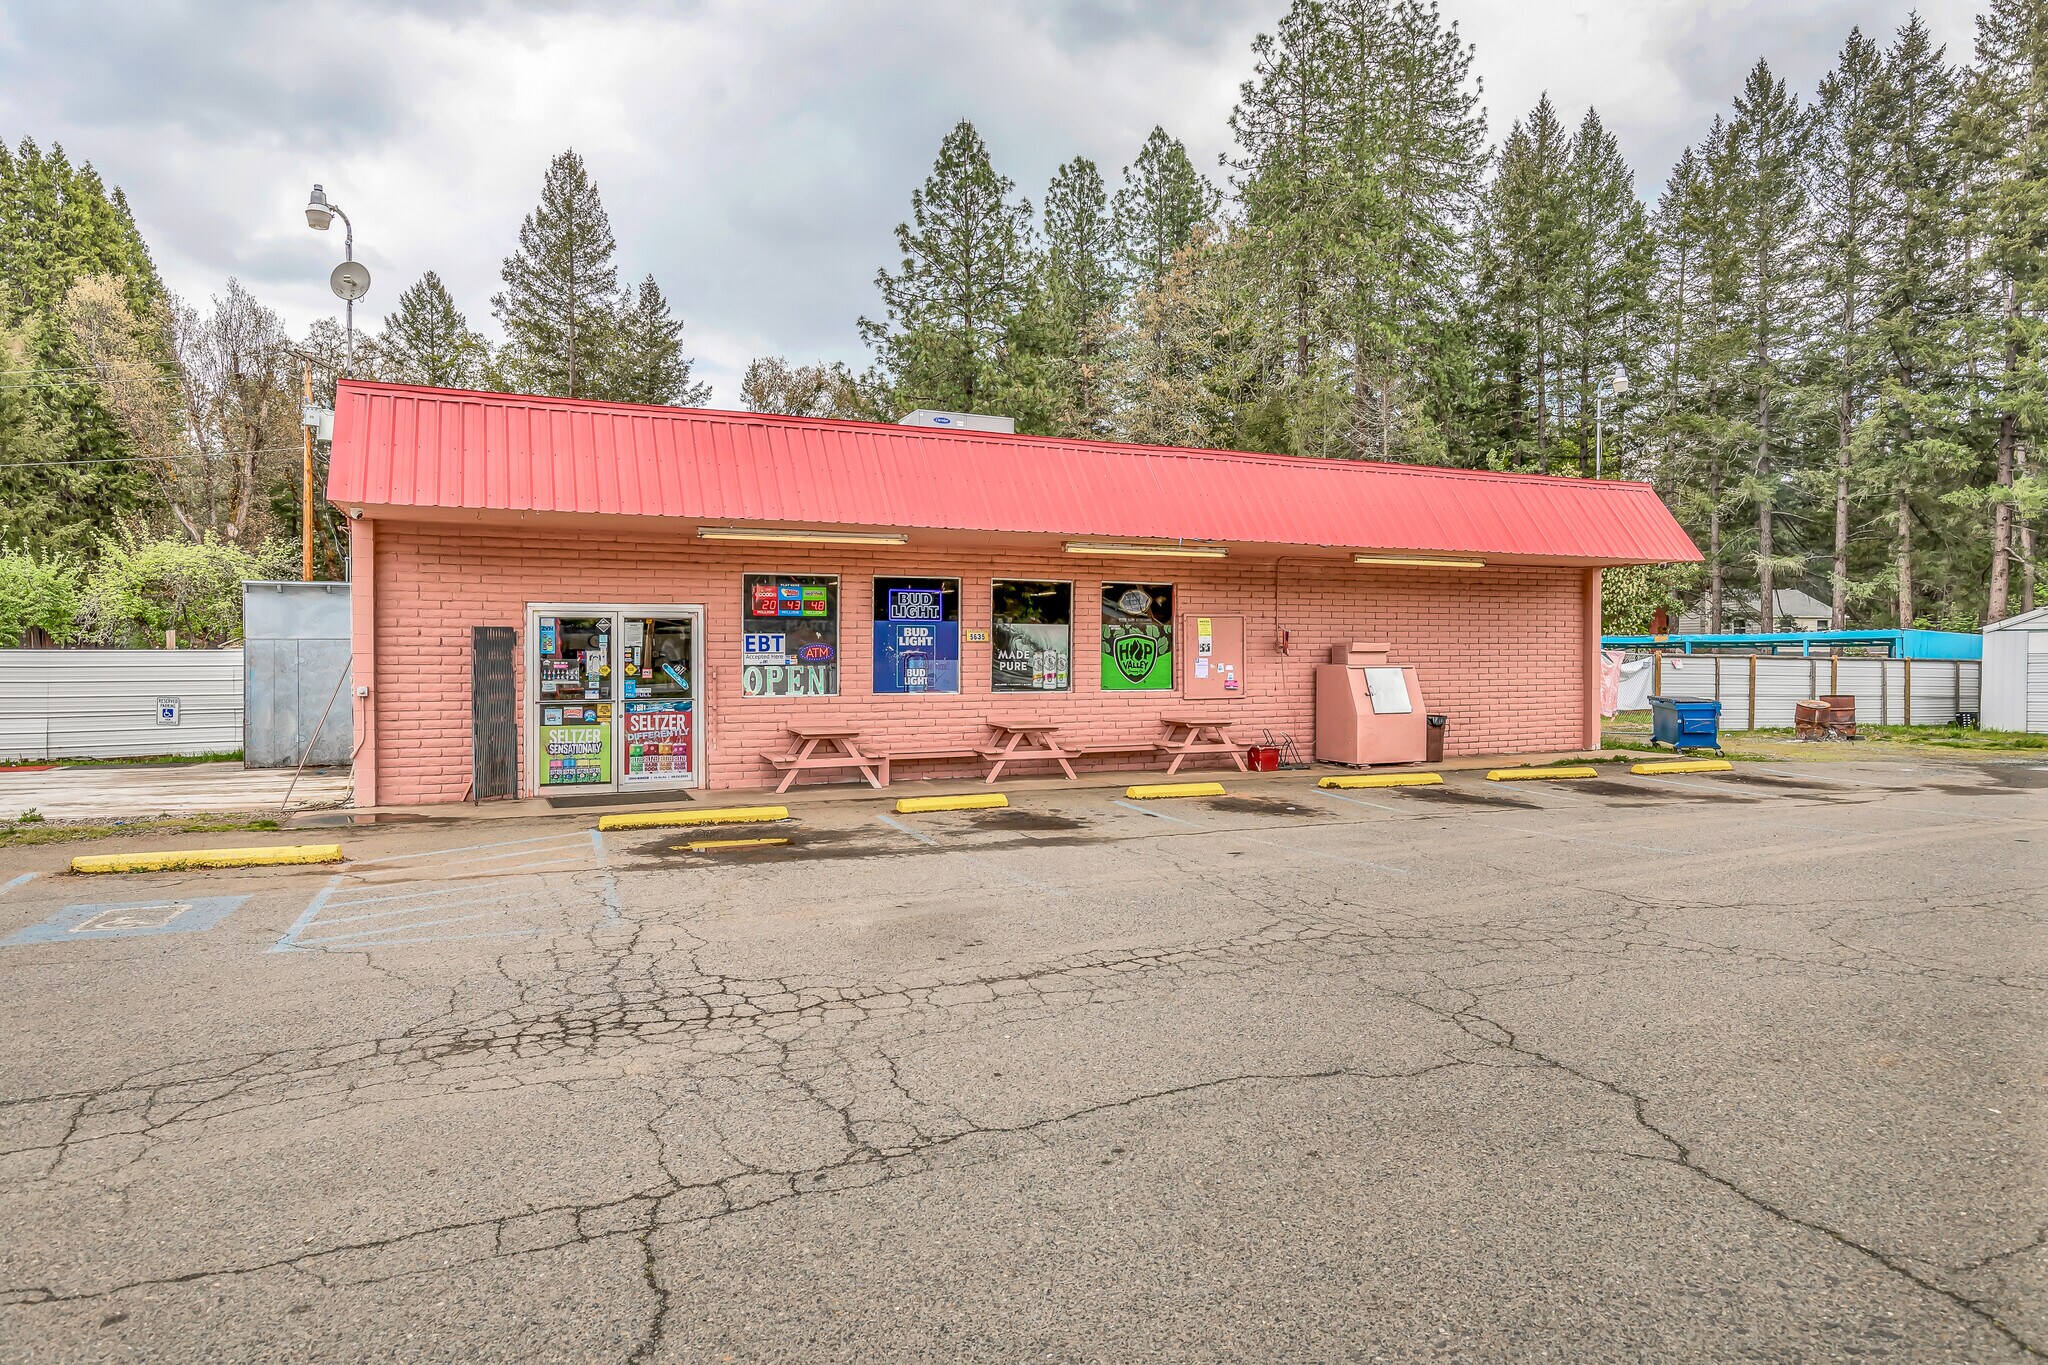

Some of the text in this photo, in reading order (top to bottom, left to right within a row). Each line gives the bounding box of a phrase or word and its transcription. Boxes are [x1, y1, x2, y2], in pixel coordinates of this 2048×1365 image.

[898, 592, 932, 605] BUD
[762, 601, 776, 610] 20
[787, 601, 800, 610] 43
[891, 605, 939, 618] LIGHT
[904, 628, 928, 637] BUD
[745, 635, 784, 652] EBT
[899, 637, 933, 646] LIGHT
[806, 647, 829, 658] ATM
[997, 650, 1030, 660] MADE
[1000, 662, 1028, 671] PURE
[1123, 661, 1149, 670] VALLEY
[906, 668, 926, 677] BUD
[743, 665, 826, 697] OPEN
[904, 677, 928, 685] LIGHT
[630, 714, 686, 731] SELTZER
[549, 729, 600, 743] SELTZER
[627, 728, 689, 741] DIFFERENTLY
[549, 743, 602, 755] SENSATIONALLY
